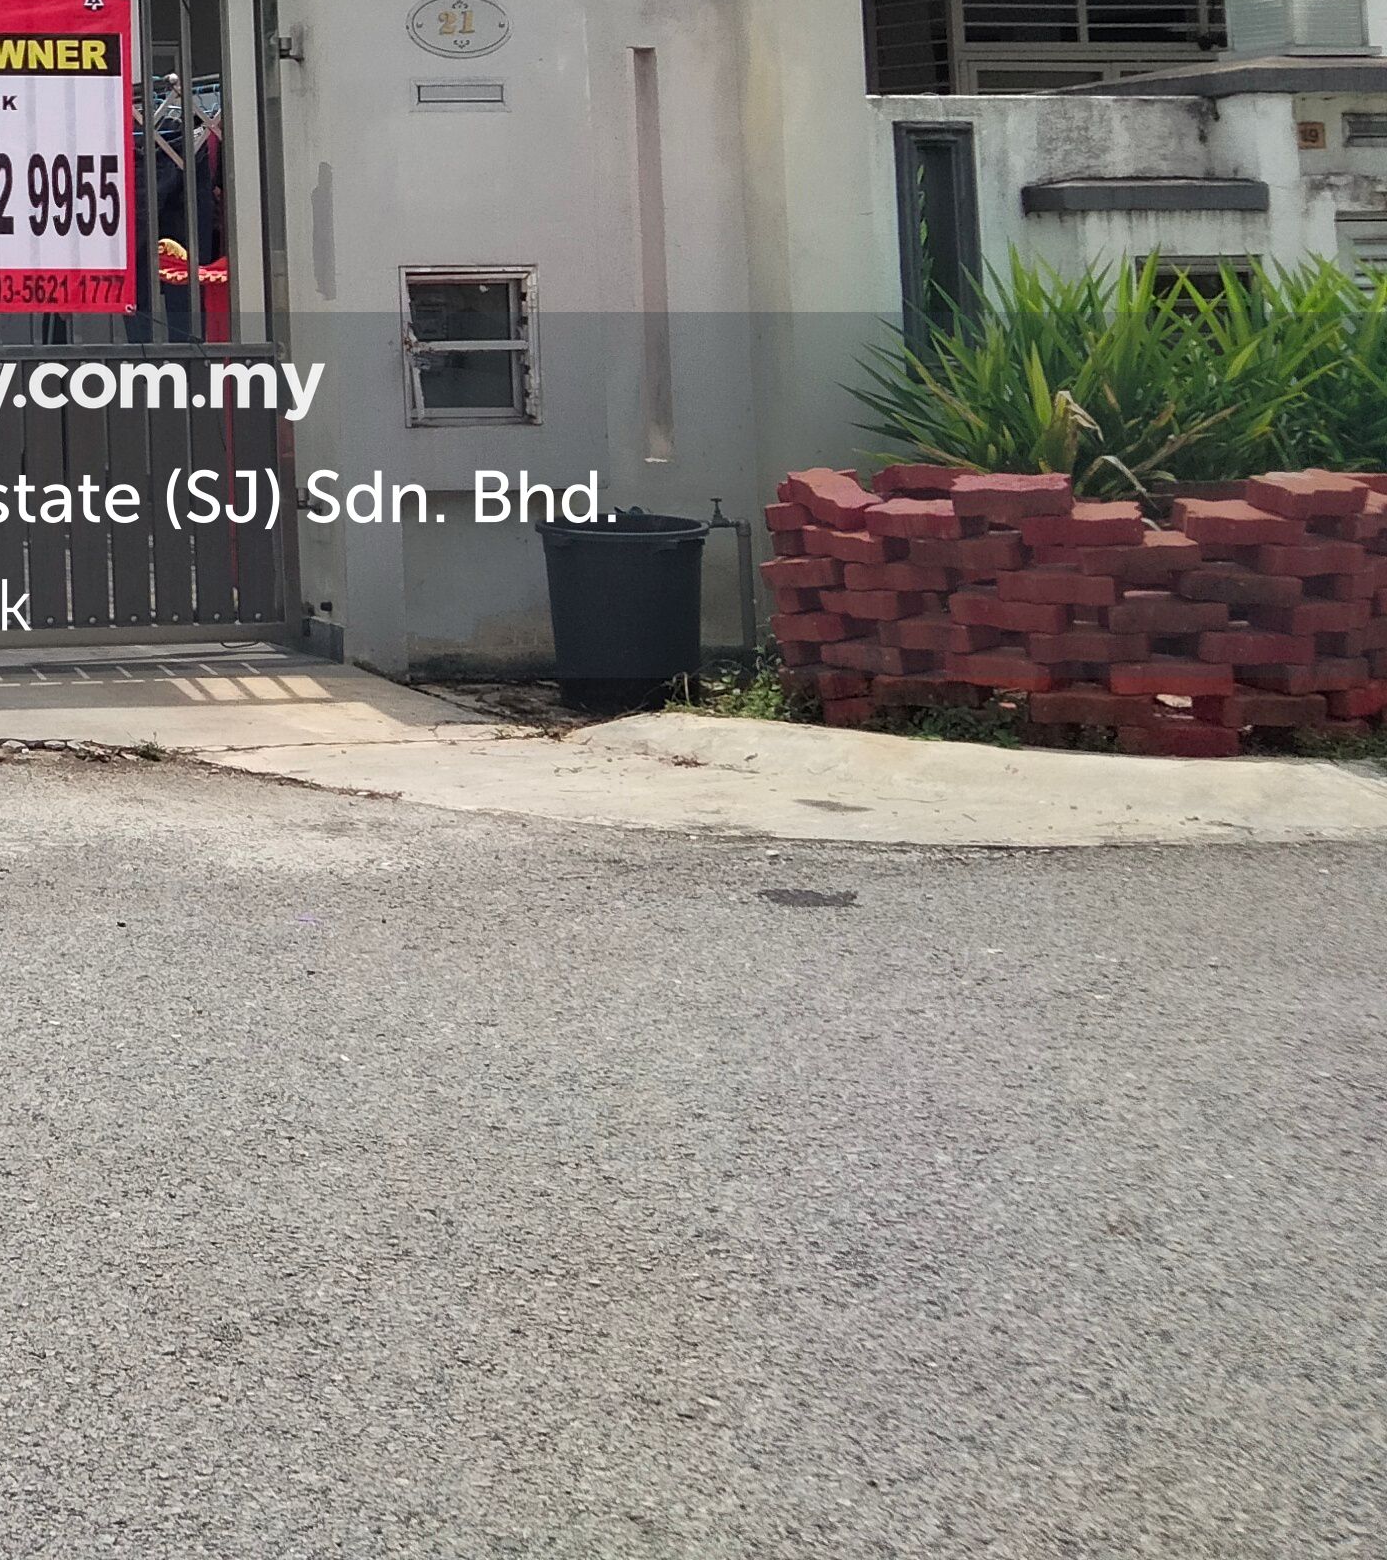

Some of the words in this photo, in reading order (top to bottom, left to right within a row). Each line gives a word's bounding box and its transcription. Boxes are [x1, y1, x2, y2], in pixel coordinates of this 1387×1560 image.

[438, 10, 475, 35] 21
[27, 153, 121, 237] 9955
[78, 274, 125, 304] 1777
